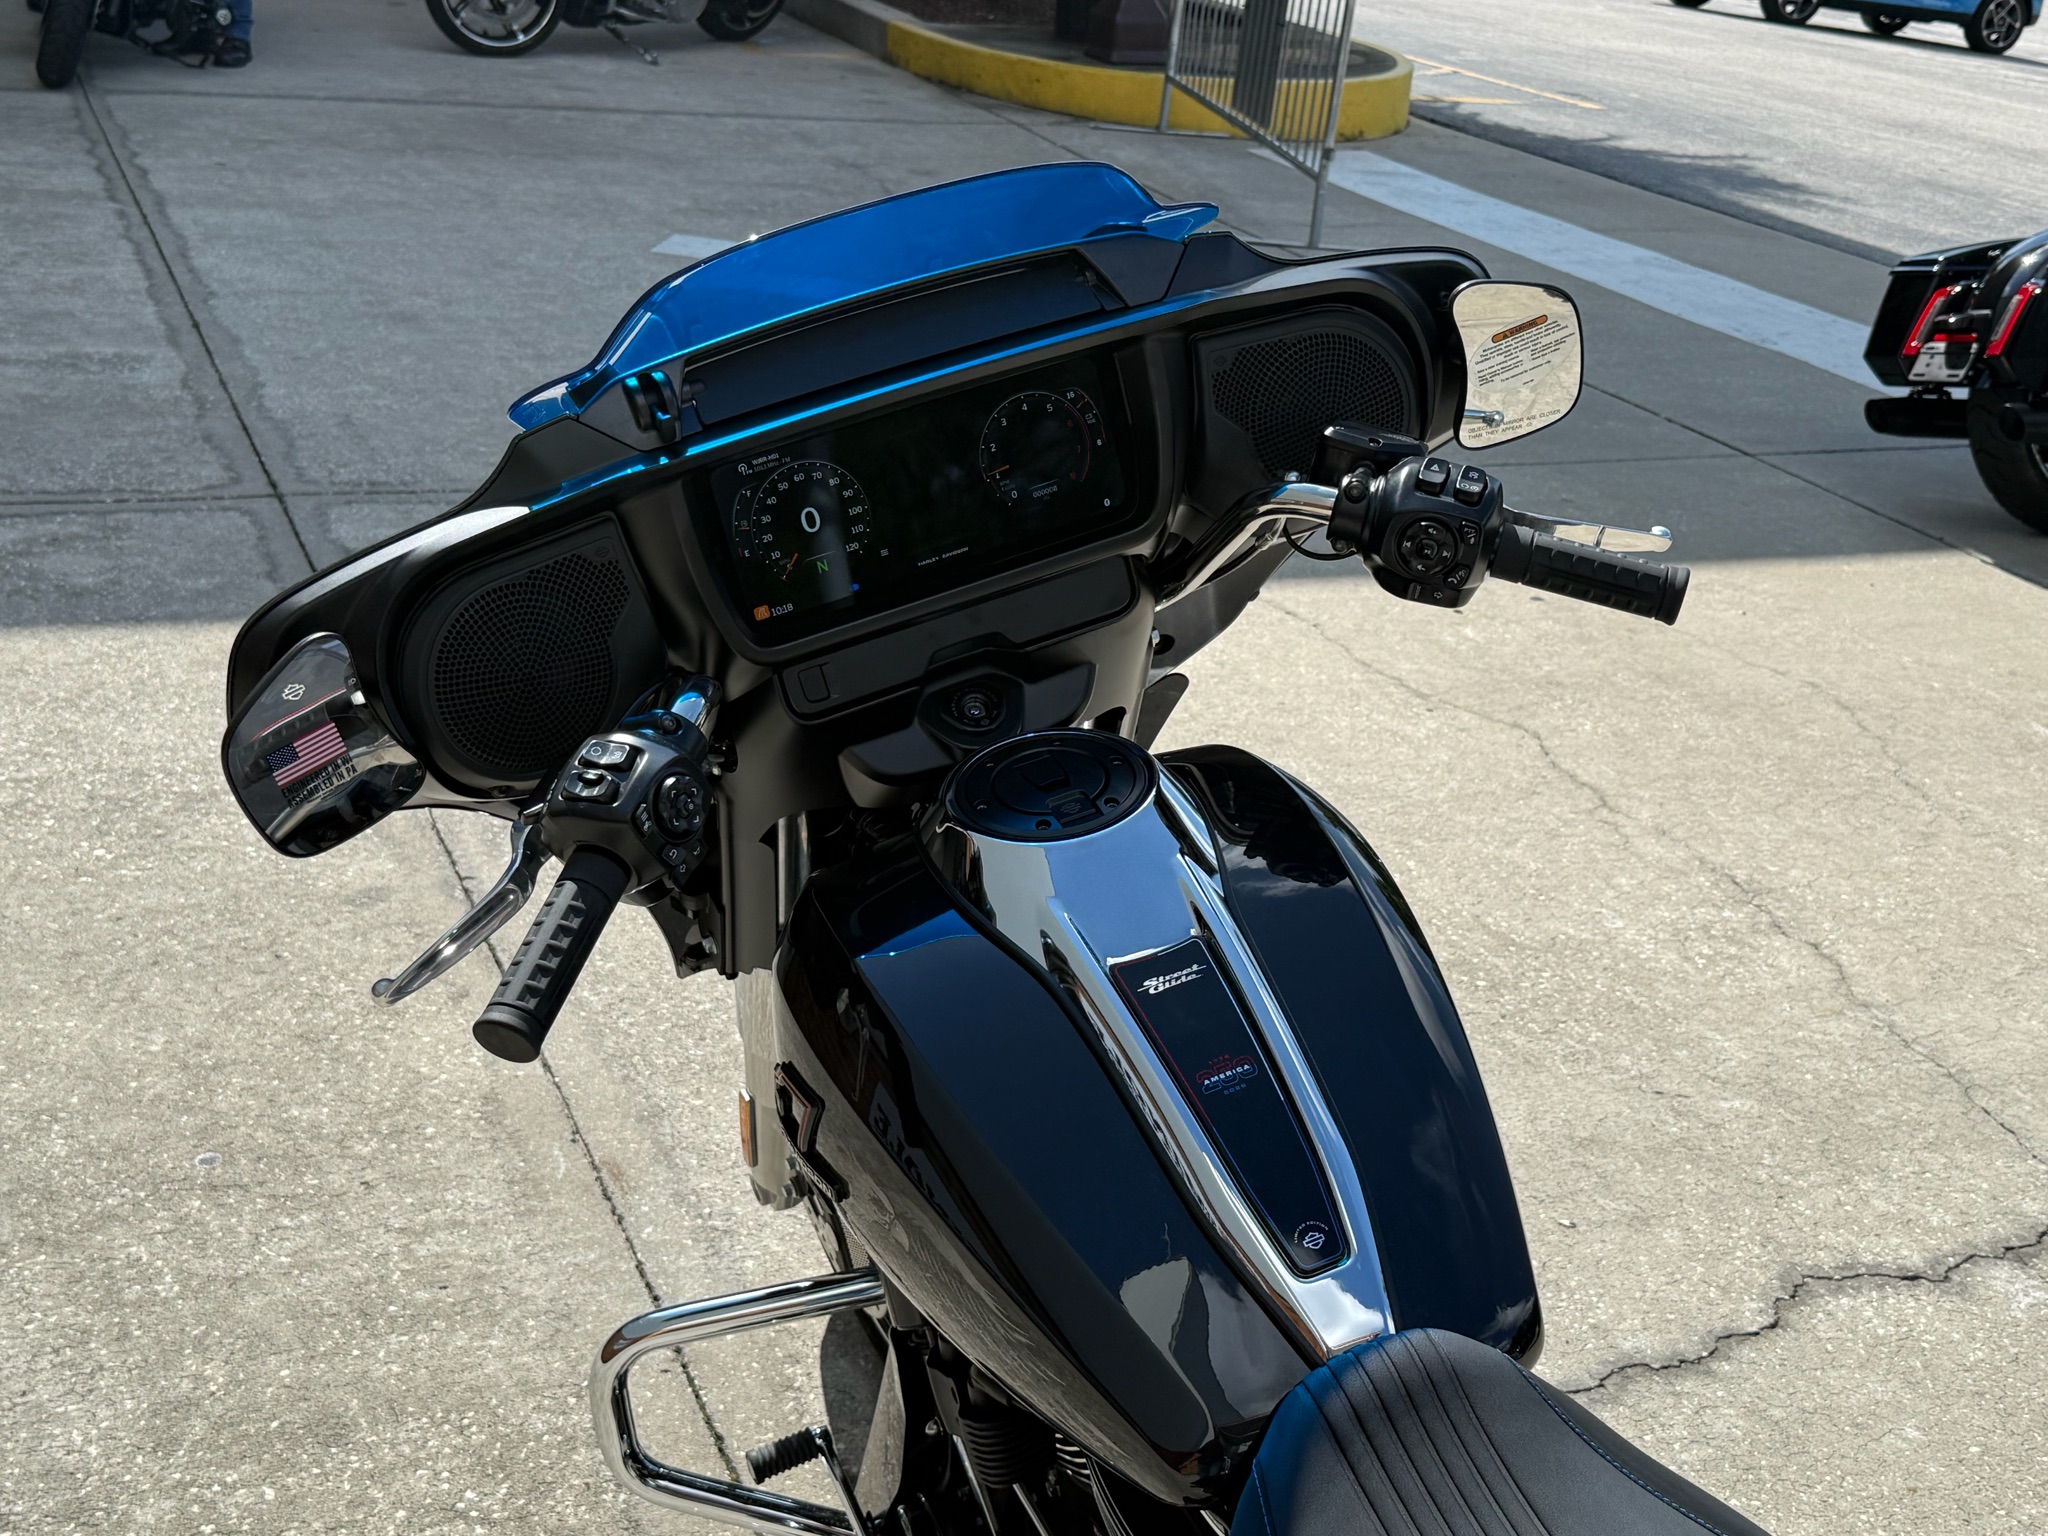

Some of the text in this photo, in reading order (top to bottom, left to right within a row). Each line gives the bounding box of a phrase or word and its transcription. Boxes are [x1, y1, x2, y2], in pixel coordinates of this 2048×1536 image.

[1509, 320, 1538, 334] WARNING
[1066, 391, 1075, 399] 16
[1021, 403, 1028, 411] 4
[1047, 404, 1053, 412] 5
[1540, 409, 1561, 419] CLOSER
[1001, 418, 1007, 426] 3
[1468, 424, 1523, 440] THAN THEY APPEAR
[990, 444, 996, 452] 2
[794, 473, 805, 482] 60
[812, 472, 823, 480] 70
[829, 477, 840, 486] 80
[777, 482, 789, 491] 50
[746, 490, 752, 498] F
[843, 489, 854, 497] 90
[1011, 490, 1018, 499] 0
[766, 496, 777, 505] 40
[848, 506, 863, 515] 100
[761, 515, 771, 524] 30
[800, 507, 821, 533] 0
[851, 524, 864, 534] 110
[762, 534, 773, 543] 20
[845, 542, 859, 552] 120
[771, 551, 781, 560] 10
[816, 559, 829, 574] N
[771, 603, 793, 617] 10:18
[281, 753, 353, 798] ENGINEERED IN WI
[289, 778, 336, 809] ASSEMBLED
[335, 771, 347, 784] IN
[347, 764, 358, 779] PA
[1140, 964, 1203, 989] Street
[1149, 974, 1203, 994] Glide
[1204, 1064, 1250, 1085] AMERICA
